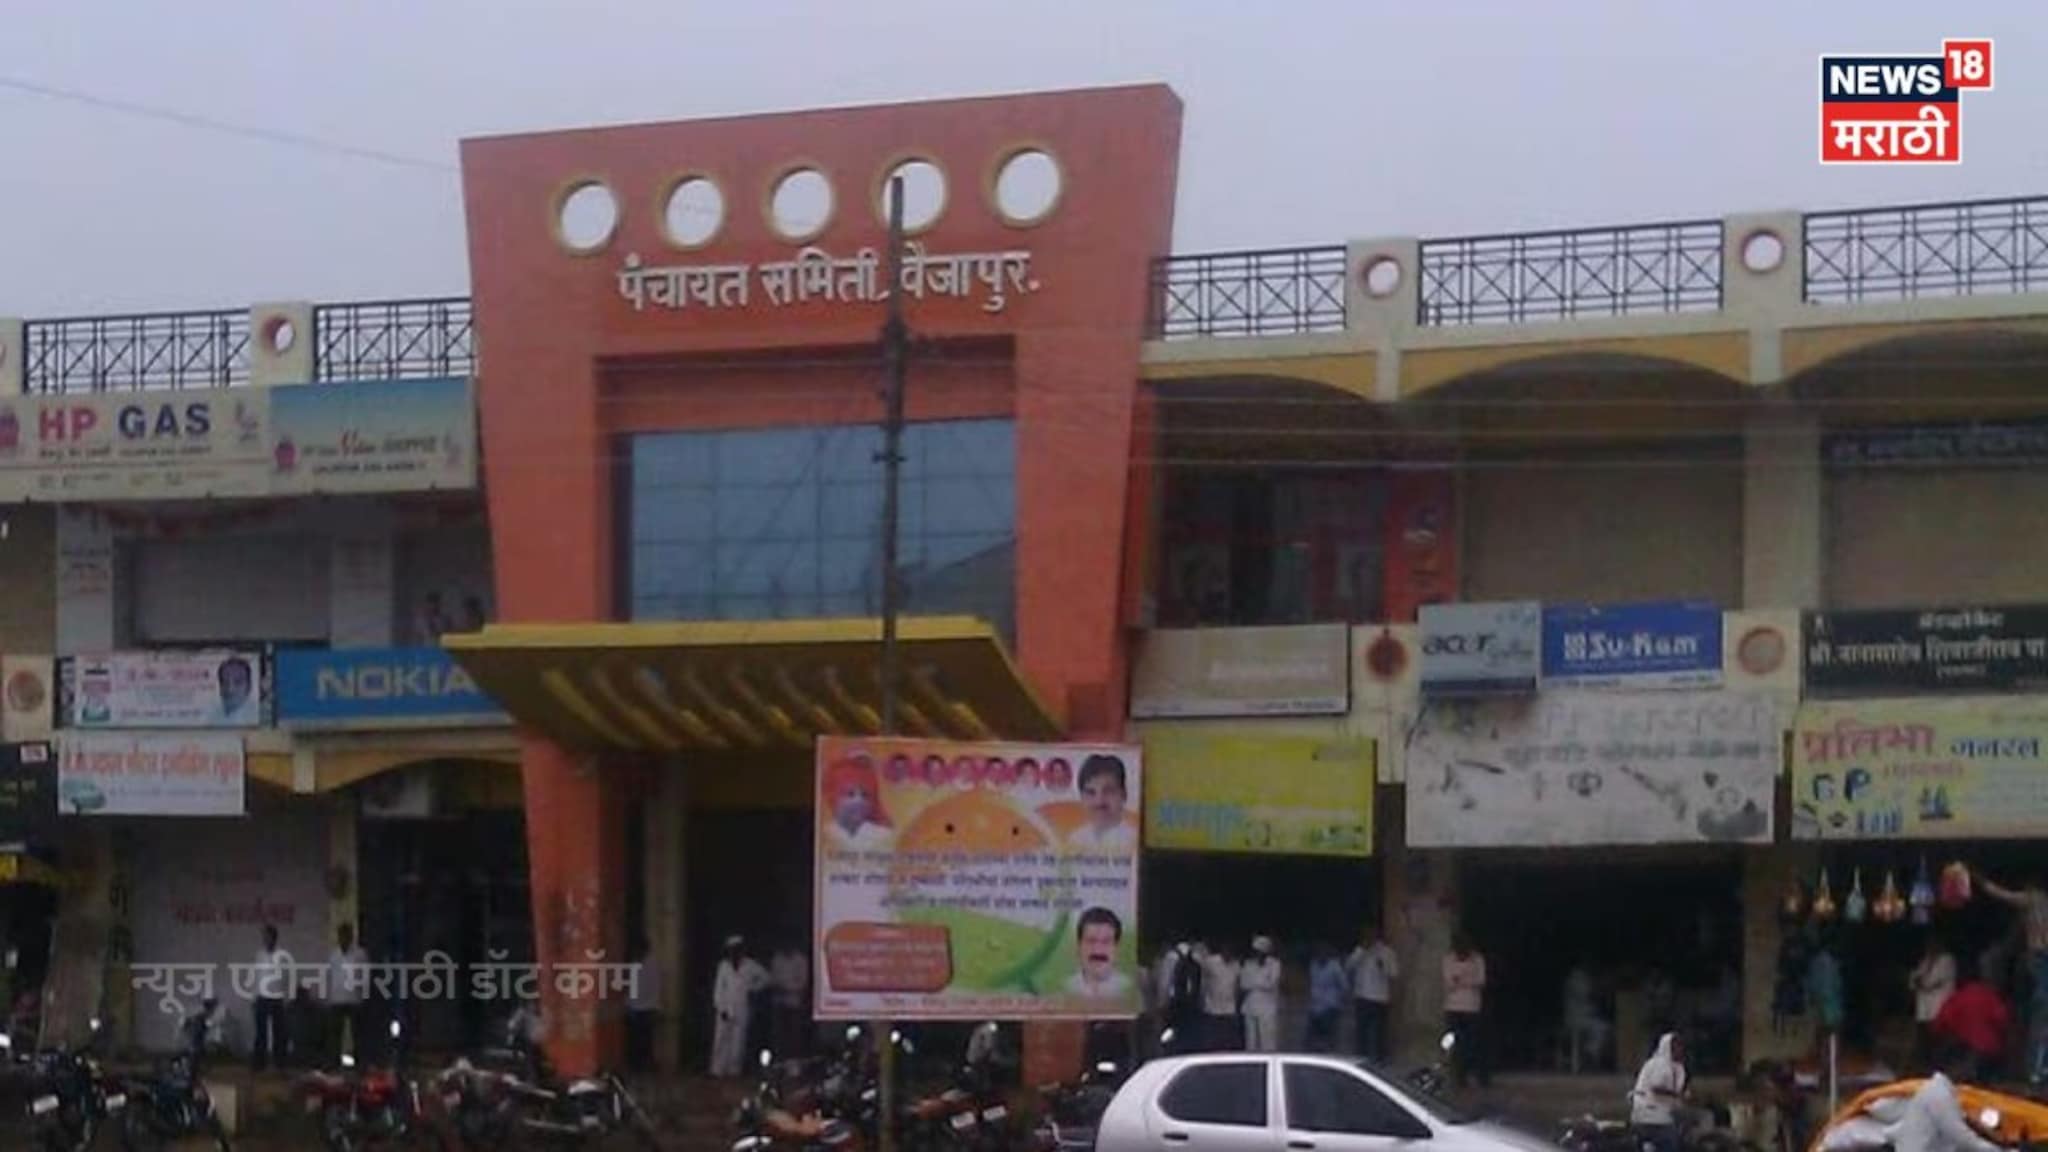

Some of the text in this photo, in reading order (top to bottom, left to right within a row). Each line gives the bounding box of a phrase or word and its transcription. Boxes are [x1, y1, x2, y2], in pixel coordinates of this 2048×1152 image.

[617, 252, 749, 310] पंचायत
[39, 402, 211, 441] HP GAS
[1422, 632, 1497, 656] acer
[1588, 631, 1698, 660] Su-Kam
[317, 664, 480, 701] NOKIA
[1950, 737, 2040, 758] जनरल
